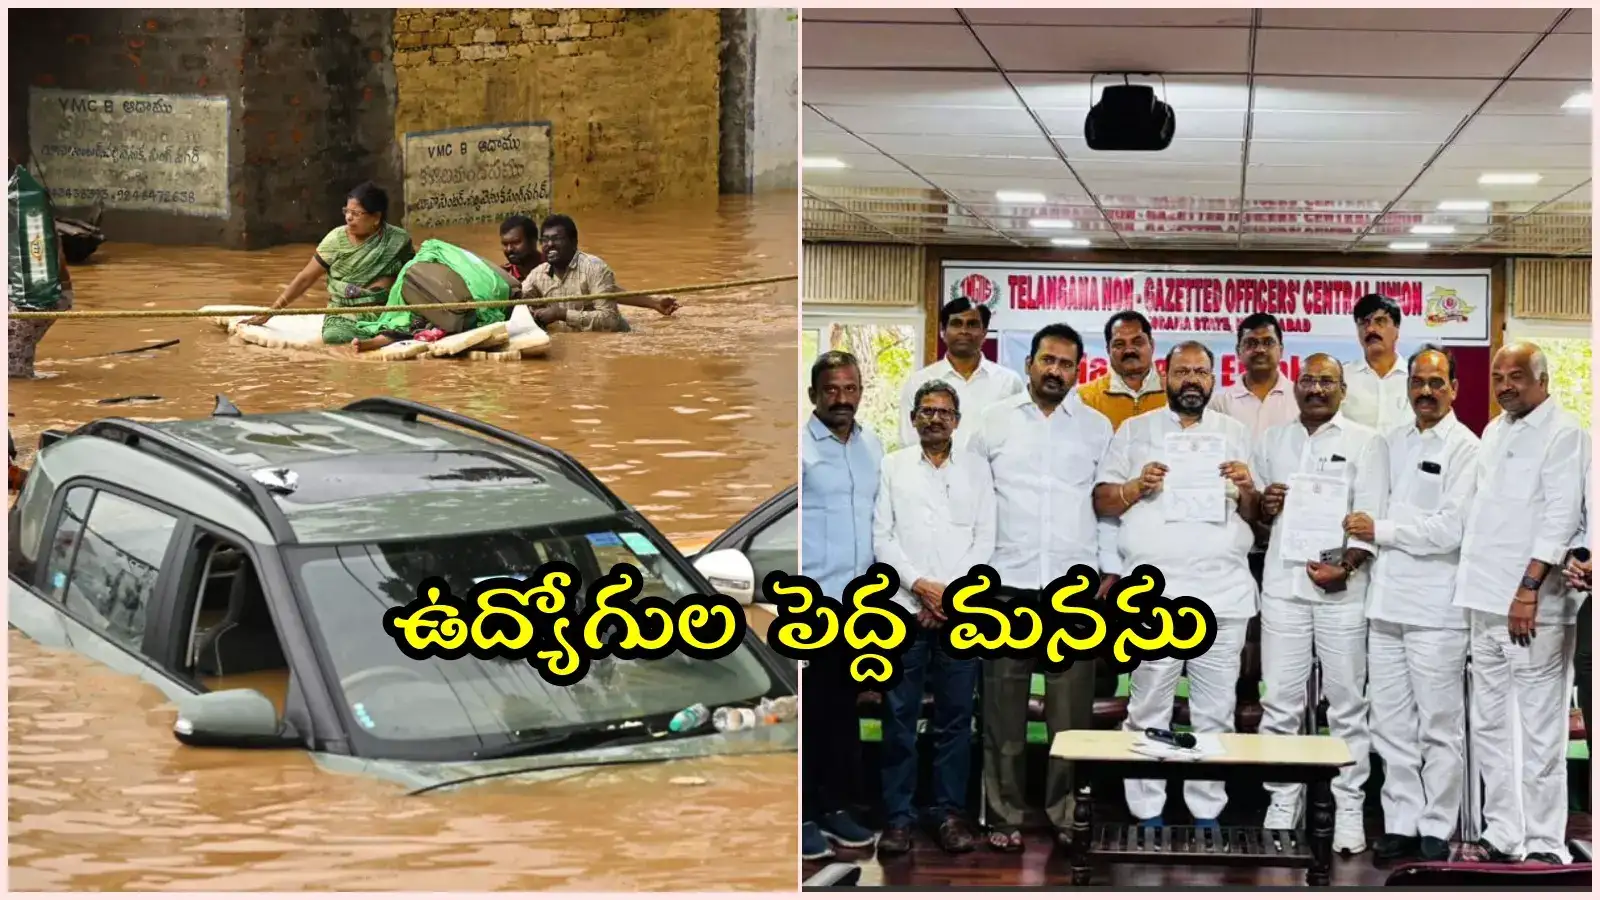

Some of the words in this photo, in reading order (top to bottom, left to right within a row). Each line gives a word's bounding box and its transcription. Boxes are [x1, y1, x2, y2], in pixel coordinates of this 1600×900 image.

[1008, 275, 1100, 312] TELANGANA
[1101, 277, 1134, 312] NON
[1143, 277, 1221, 313] GAZETTED
